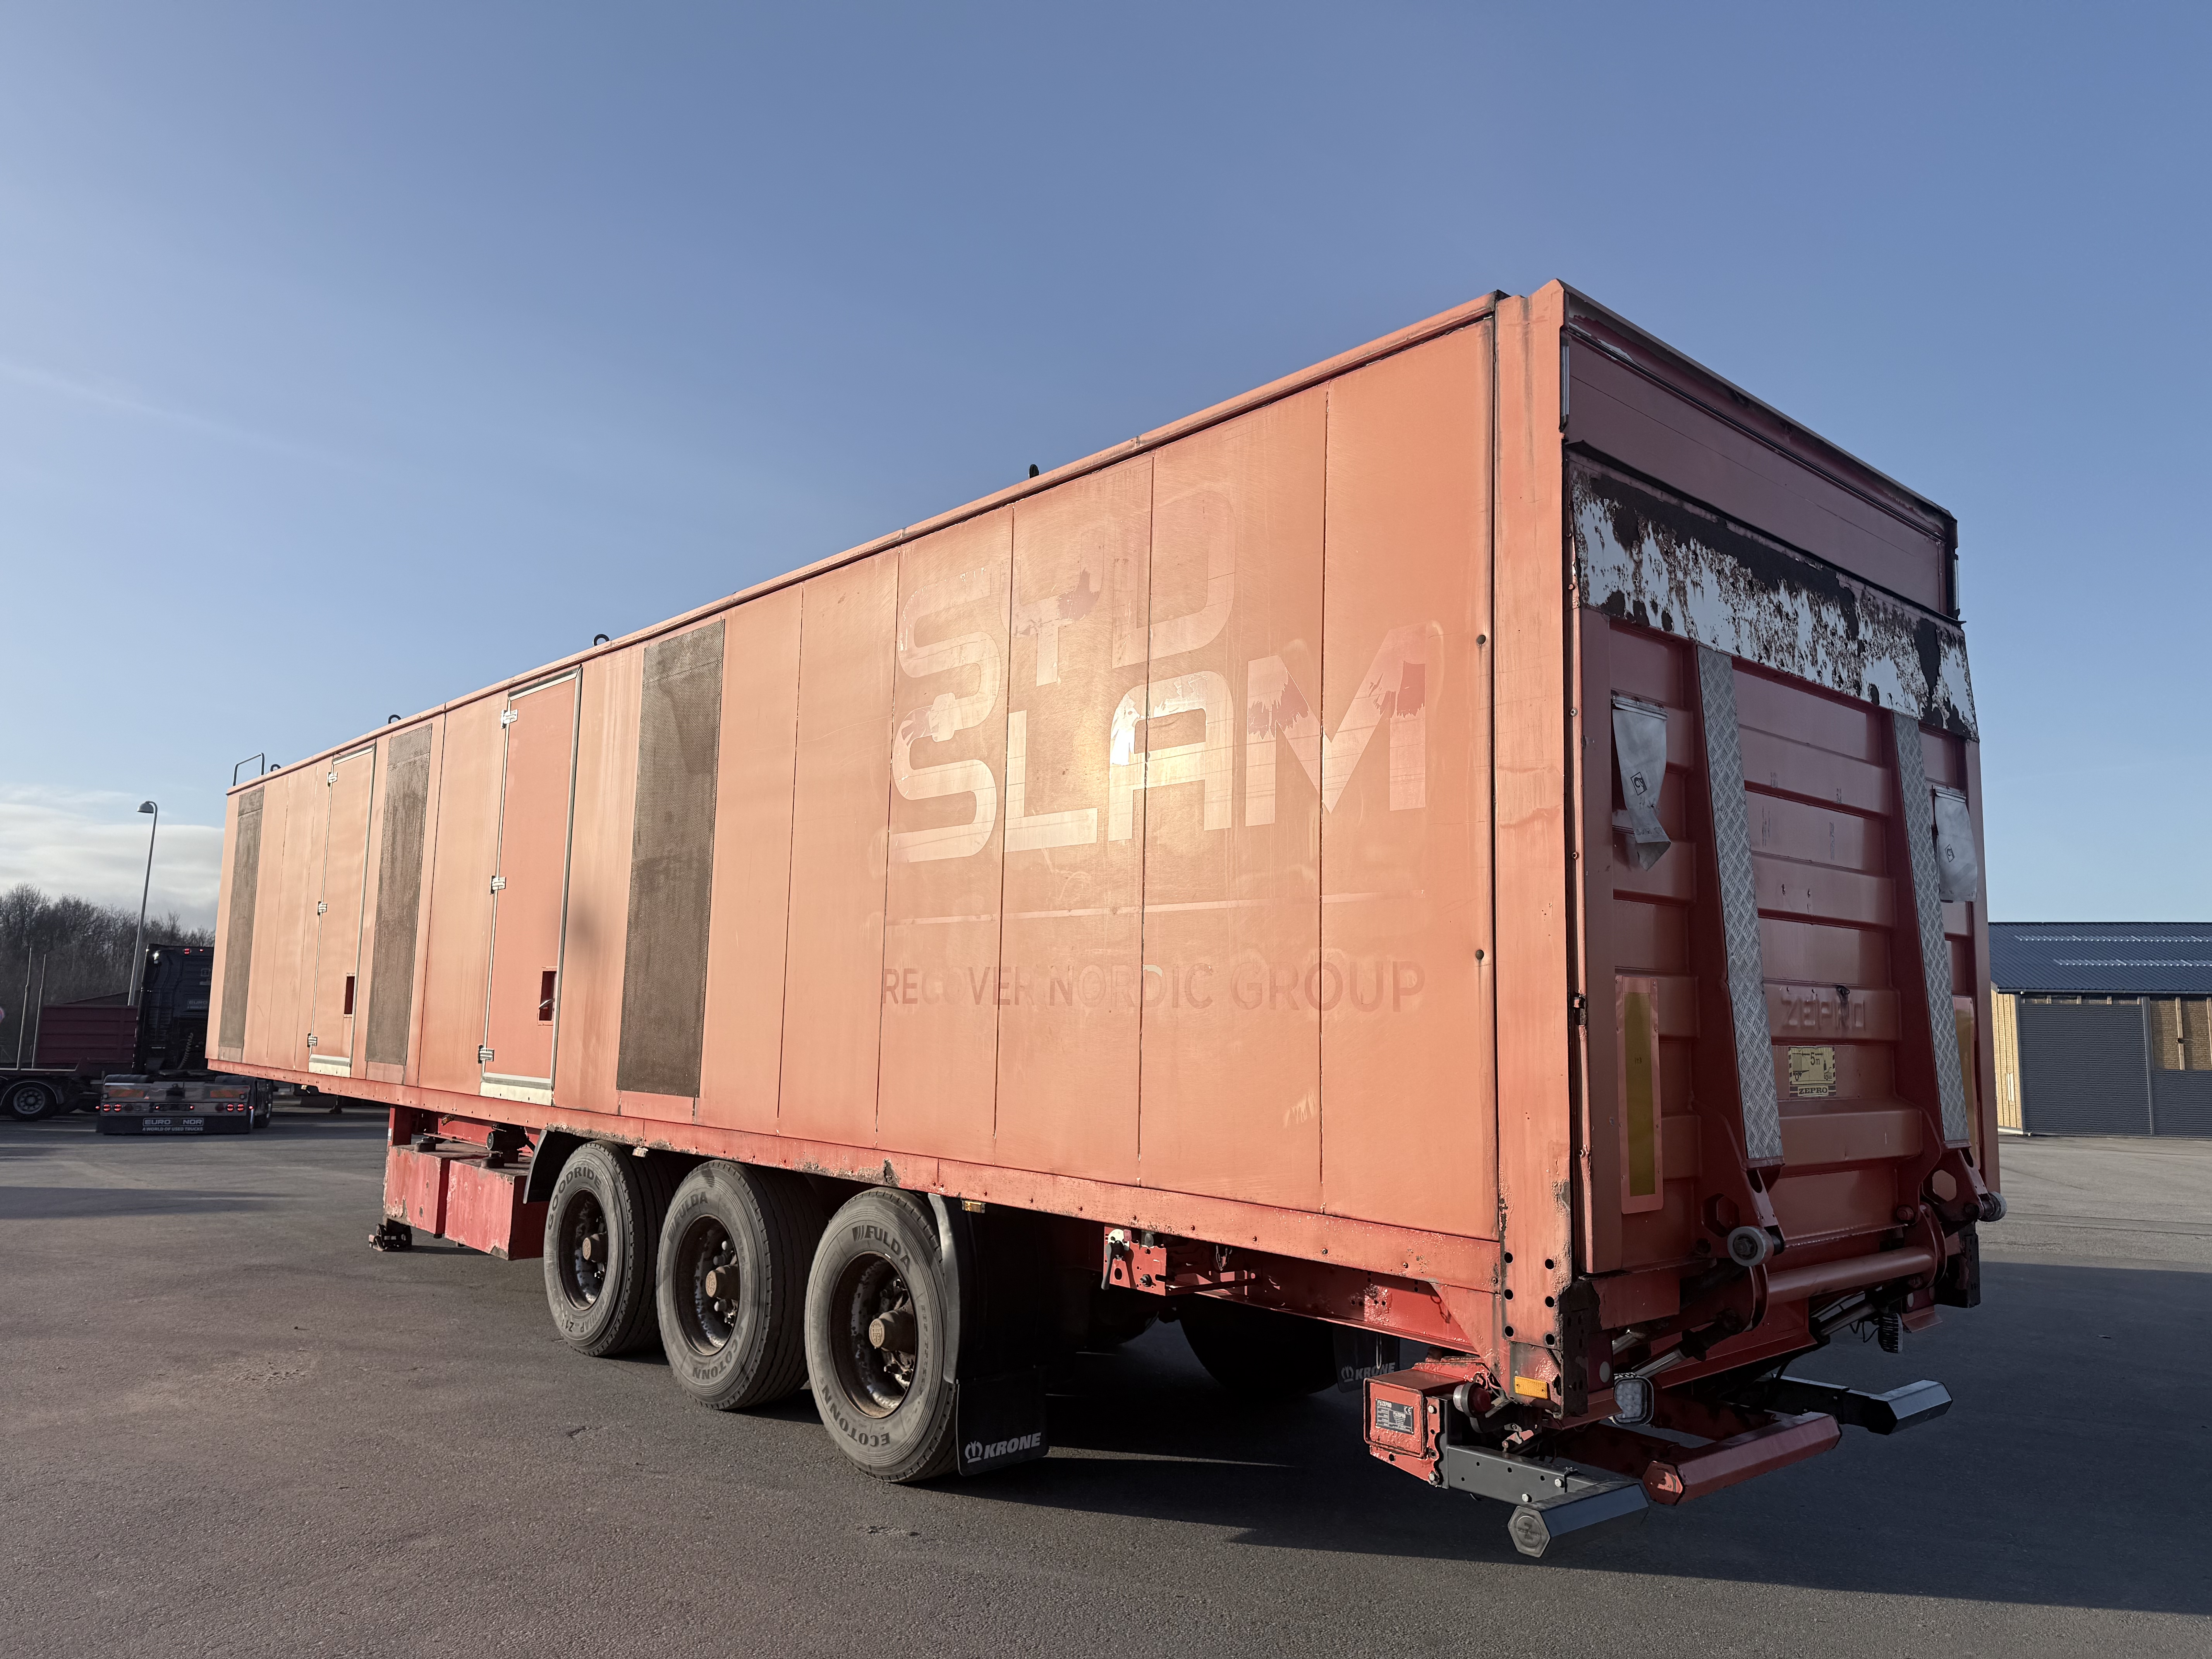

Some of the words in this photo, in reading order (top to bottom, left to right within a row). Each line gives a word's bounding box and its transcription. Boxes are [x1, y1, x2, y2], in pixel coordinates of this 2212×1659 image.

[889, 623, 1426, 863] SLAM
[883, 966, 1035, 1006] RECOVER
[1049, 963, 1213, 1008] NORDIC
[1230, 960, 1425, 1013] GROUP
[548, 1167, 601, 1230] GOODRIDE
[864, 1225, 910, 1274] FULDA
[1355, 1362, 1396, 1380] KRONE
[822, 1385, 891, 1447] ECOTONN
[984, 1432, 1041, 1459] KRONE
